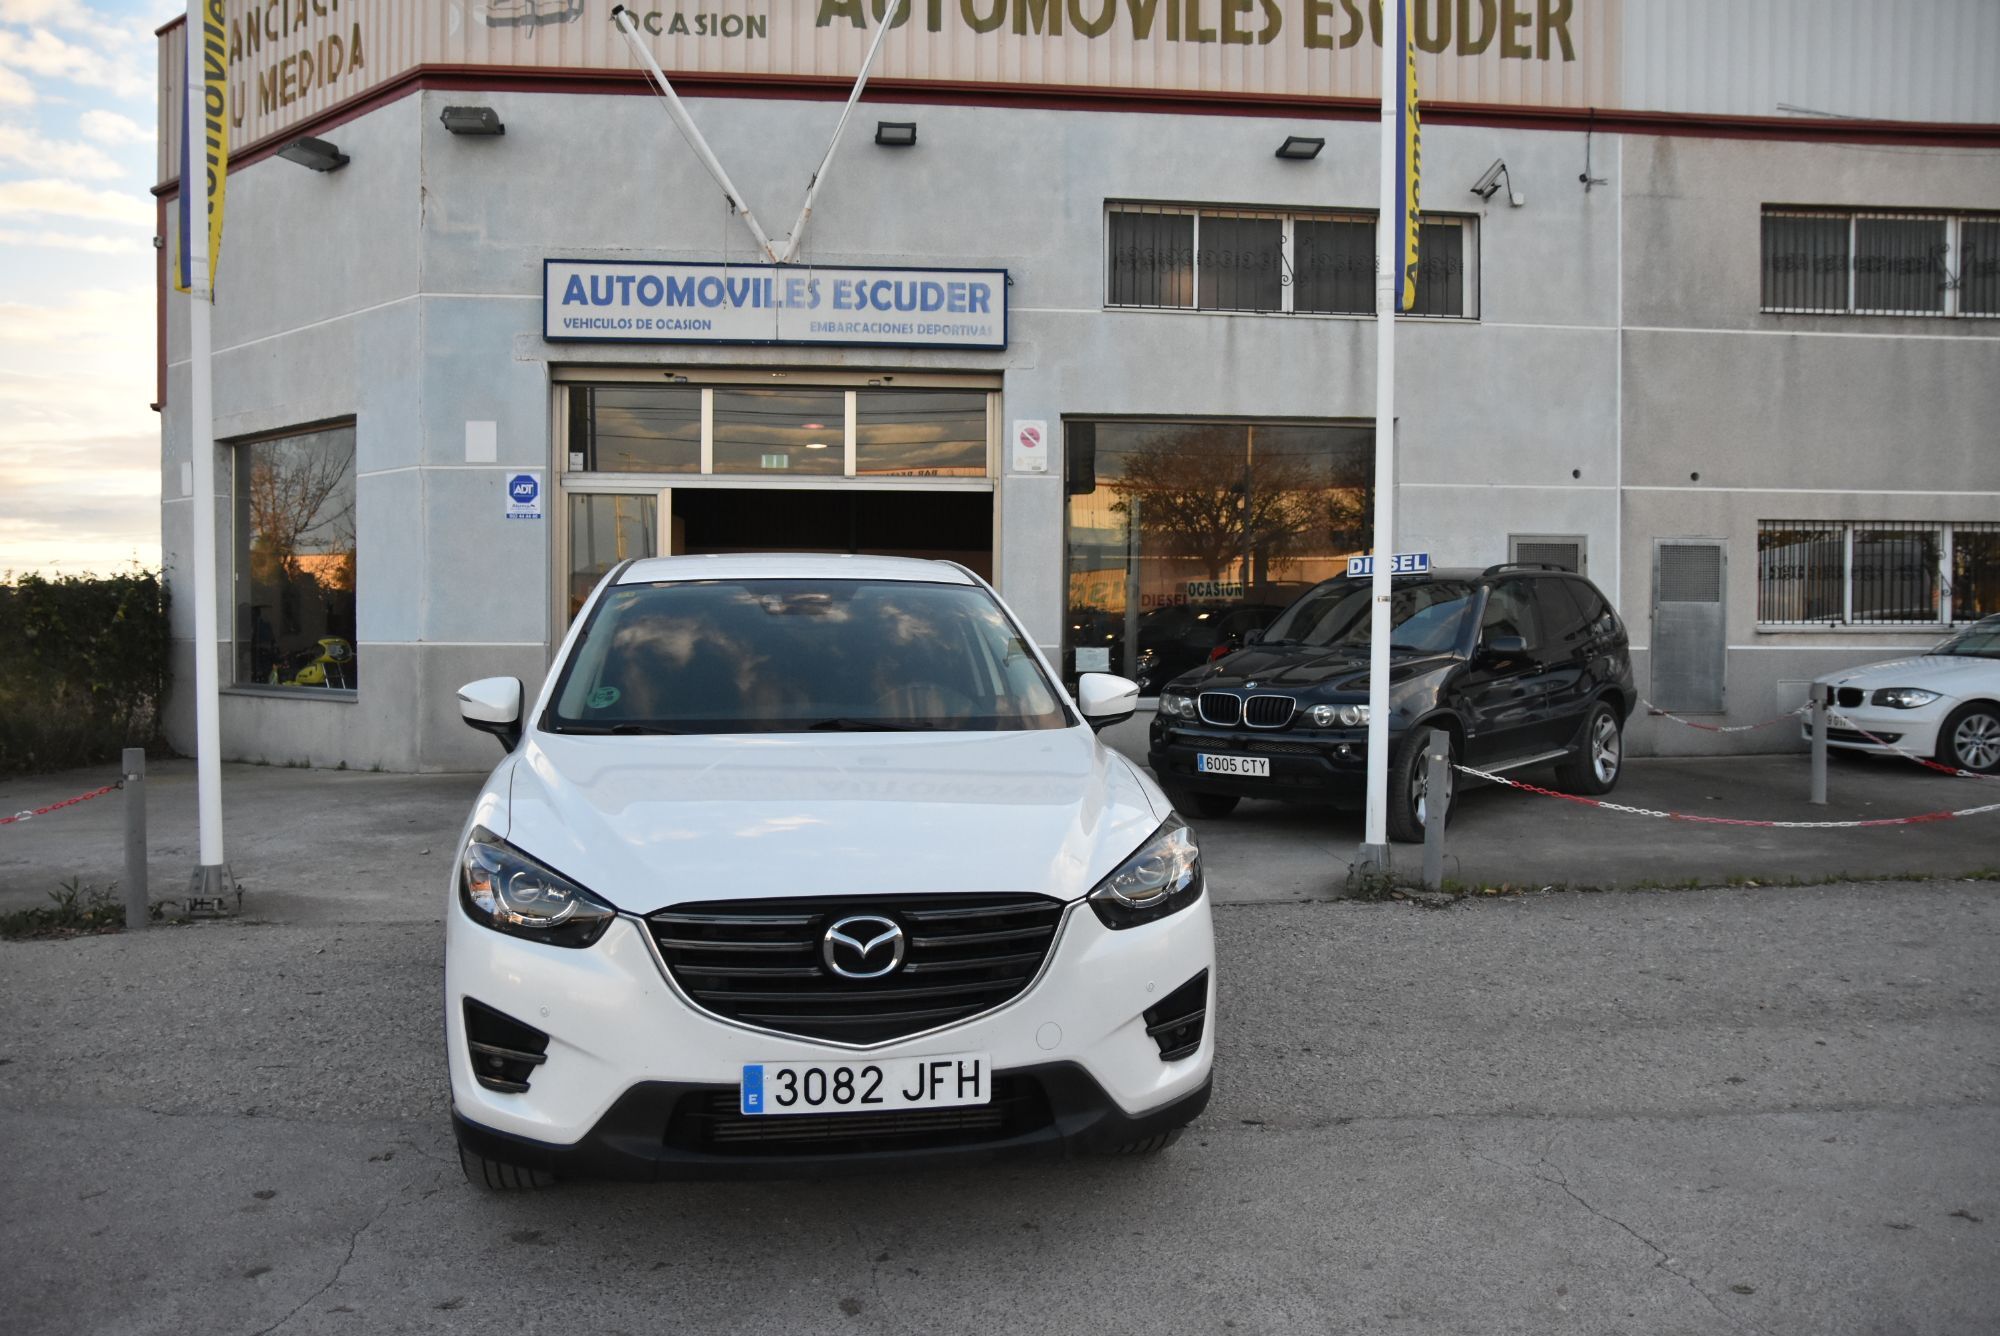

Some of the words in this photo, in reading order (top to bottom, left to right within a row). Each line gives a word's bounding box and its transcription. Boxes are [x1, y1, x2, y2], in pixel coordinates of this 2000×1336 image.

[615, 10, 767, 40] OCASION
[259, 23, 364, 117] MEDIDA
[562, 274, 820, 310] AUTOMOVILES
[833, 279, 991, 313] ESCUDER
[563, 317, 632, 330] VEHICULOS
[636, 319, 652, 330] DE
[656, 319, 712, 331] OCASION
[810, 321, 914, 335] EMBARCACIONES
[514, 484, 534, 495] ADT
[1349, 554, 1426, 574] DISEL
[1188, 582, 1243, 597] OCASION
[1206, 756, 1237, 772] 6005
[1241, 759, 1266, 774] CTY
[748, 1094, 758, 1105] E
[775, 1065, 884, 1107] 3082
[902, 1059, 980, 1101] JFH
